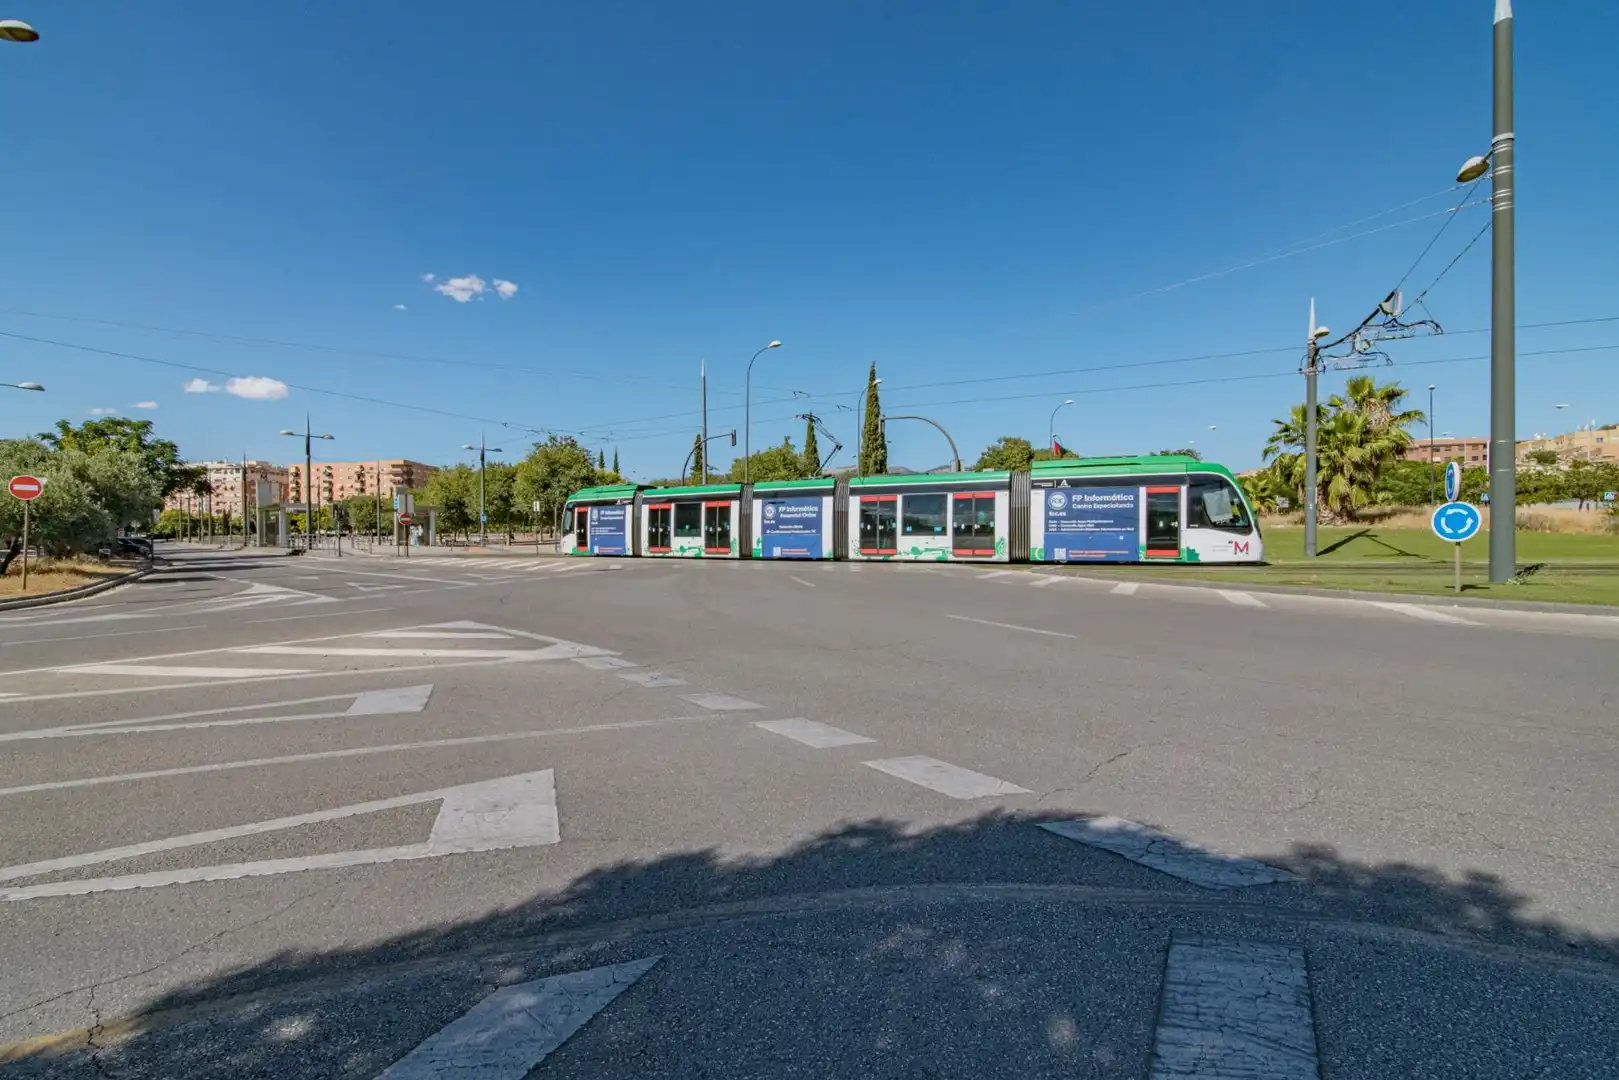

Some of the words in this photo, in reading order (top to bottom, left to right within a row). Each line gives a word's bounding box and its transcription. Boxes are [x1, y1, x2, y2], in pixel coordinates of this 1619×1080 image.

[1072, 494, 1083, 502] FP
[1084, 493, 1134, 502] Informática
[1234, 540, 1249, 553] M
